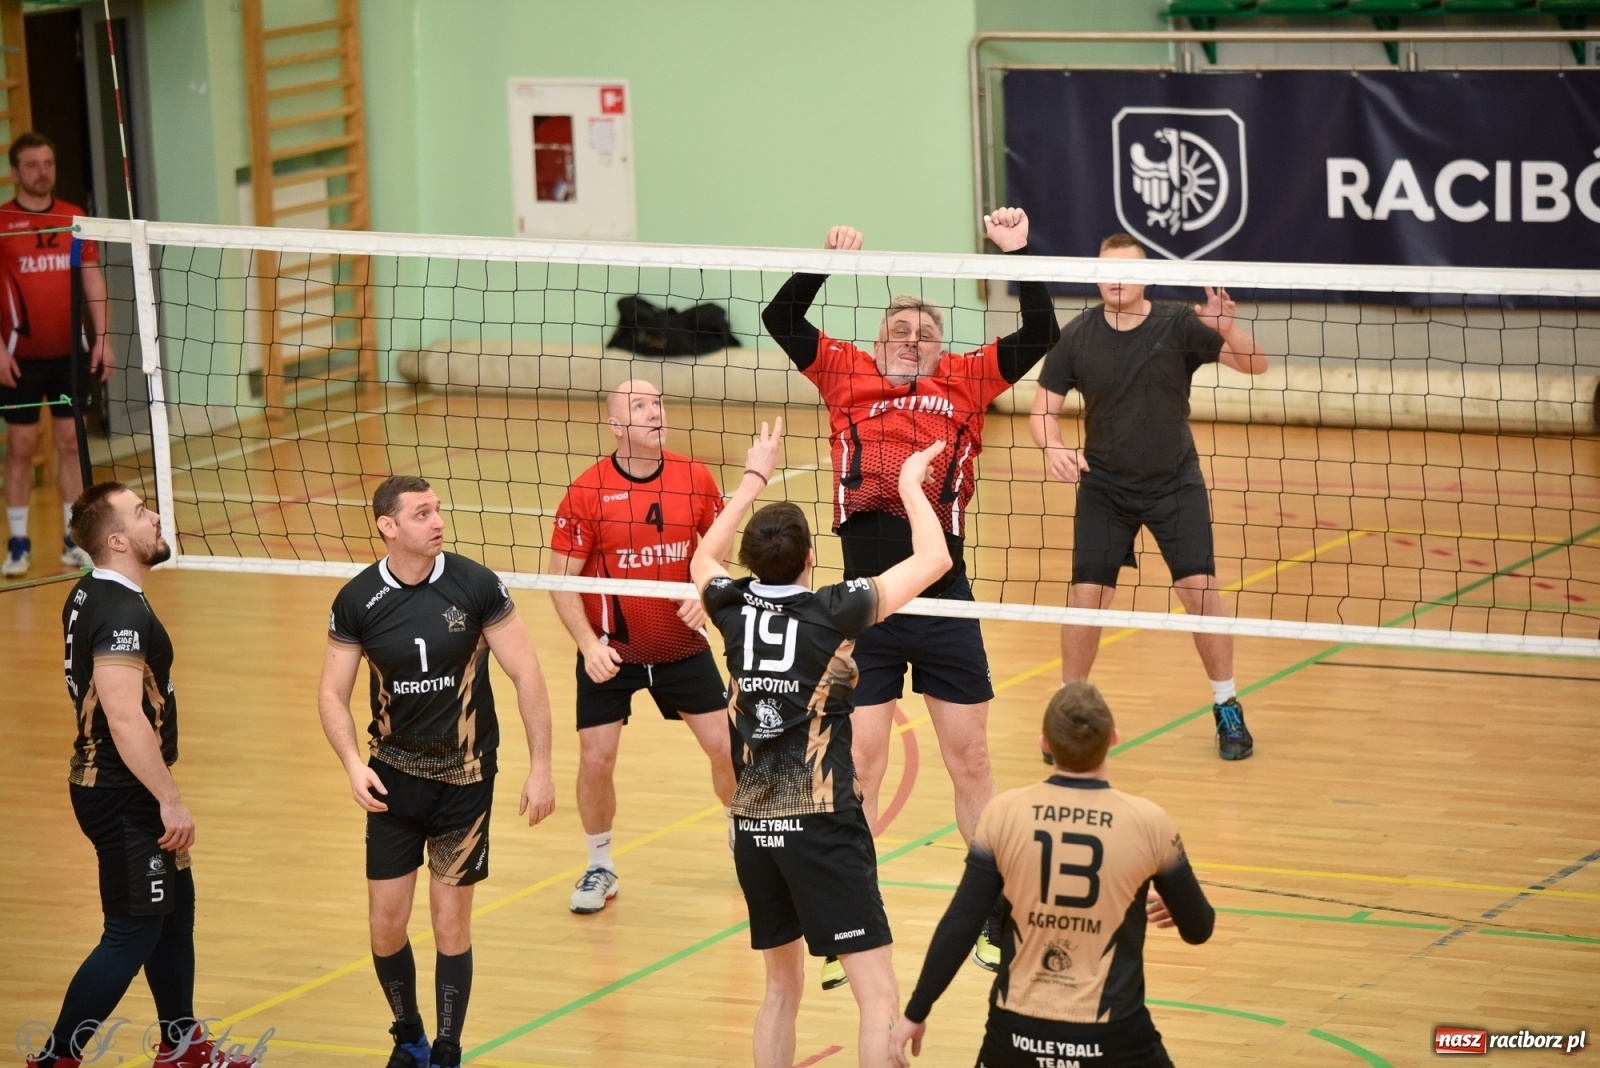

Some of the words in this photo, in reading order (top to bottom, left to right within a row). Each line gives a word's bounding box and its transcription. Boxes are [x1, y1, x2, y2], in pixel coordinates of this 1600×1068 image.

[645, 502, 663, 532] 4
[616, 540, 690, 569] ZŁOTNIK
[113, 629, 133, 637] DARK
[741, 605, 798, 672] 19
[414, 638, 429, 672] 1
[393, 675, 455, 694] AGROTIM
[738, 818, 804, 832] VOLLEYBALL
[1032, 804, 1113, 828] TAPPER
[753, 835, 785, 847] TEAM
[1033, 829, 1104, 908] 13
[151, 880, 164, 903] 5
[834, 928, 865, 941] AGROTIM
[1012, 1033, 1104, 1057] VOLLEYBALL
[1036, 1057, 1081, 1068] TEAM
